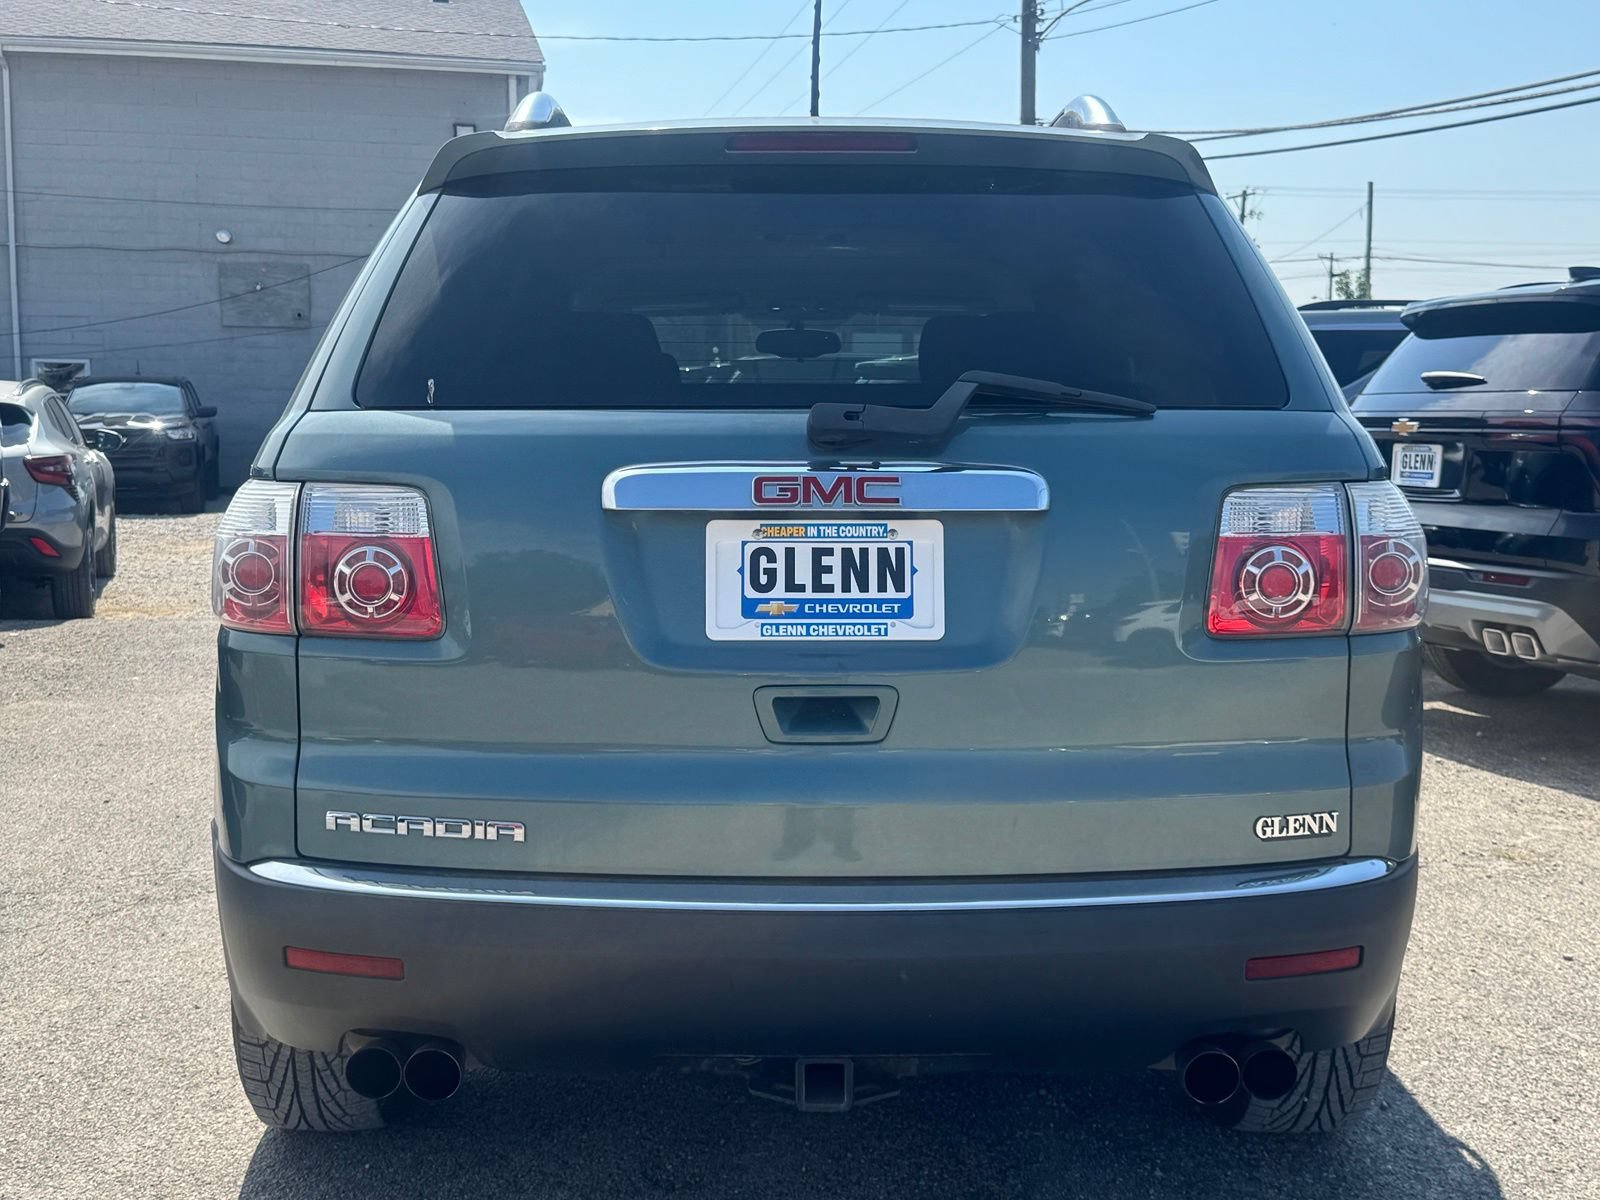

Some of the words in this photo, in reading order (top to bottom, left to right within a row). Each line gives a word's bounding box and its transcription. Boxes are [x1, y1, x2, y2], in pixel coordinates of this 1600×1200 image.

[1402, 453, 1434, 470] GLENN
[752, 475, 902, 506] GMC
[761, 526, 805, 537] CHEAPER
[807, 526, 817, 537] IN
[819, 526, 838, 537] THE
[839, 526, 887, 537] COUNTRY.
[749, 546, 906, 594] GLENN
[804, 603, 901, 613] CHEVROLET
[762, 624, 807, 636] GLENN
[809, 624, 887, 636] CHEVROLET
[325, 810, 526, 843] ACADIA
[1254, 811, 1339, 839] GLENN
